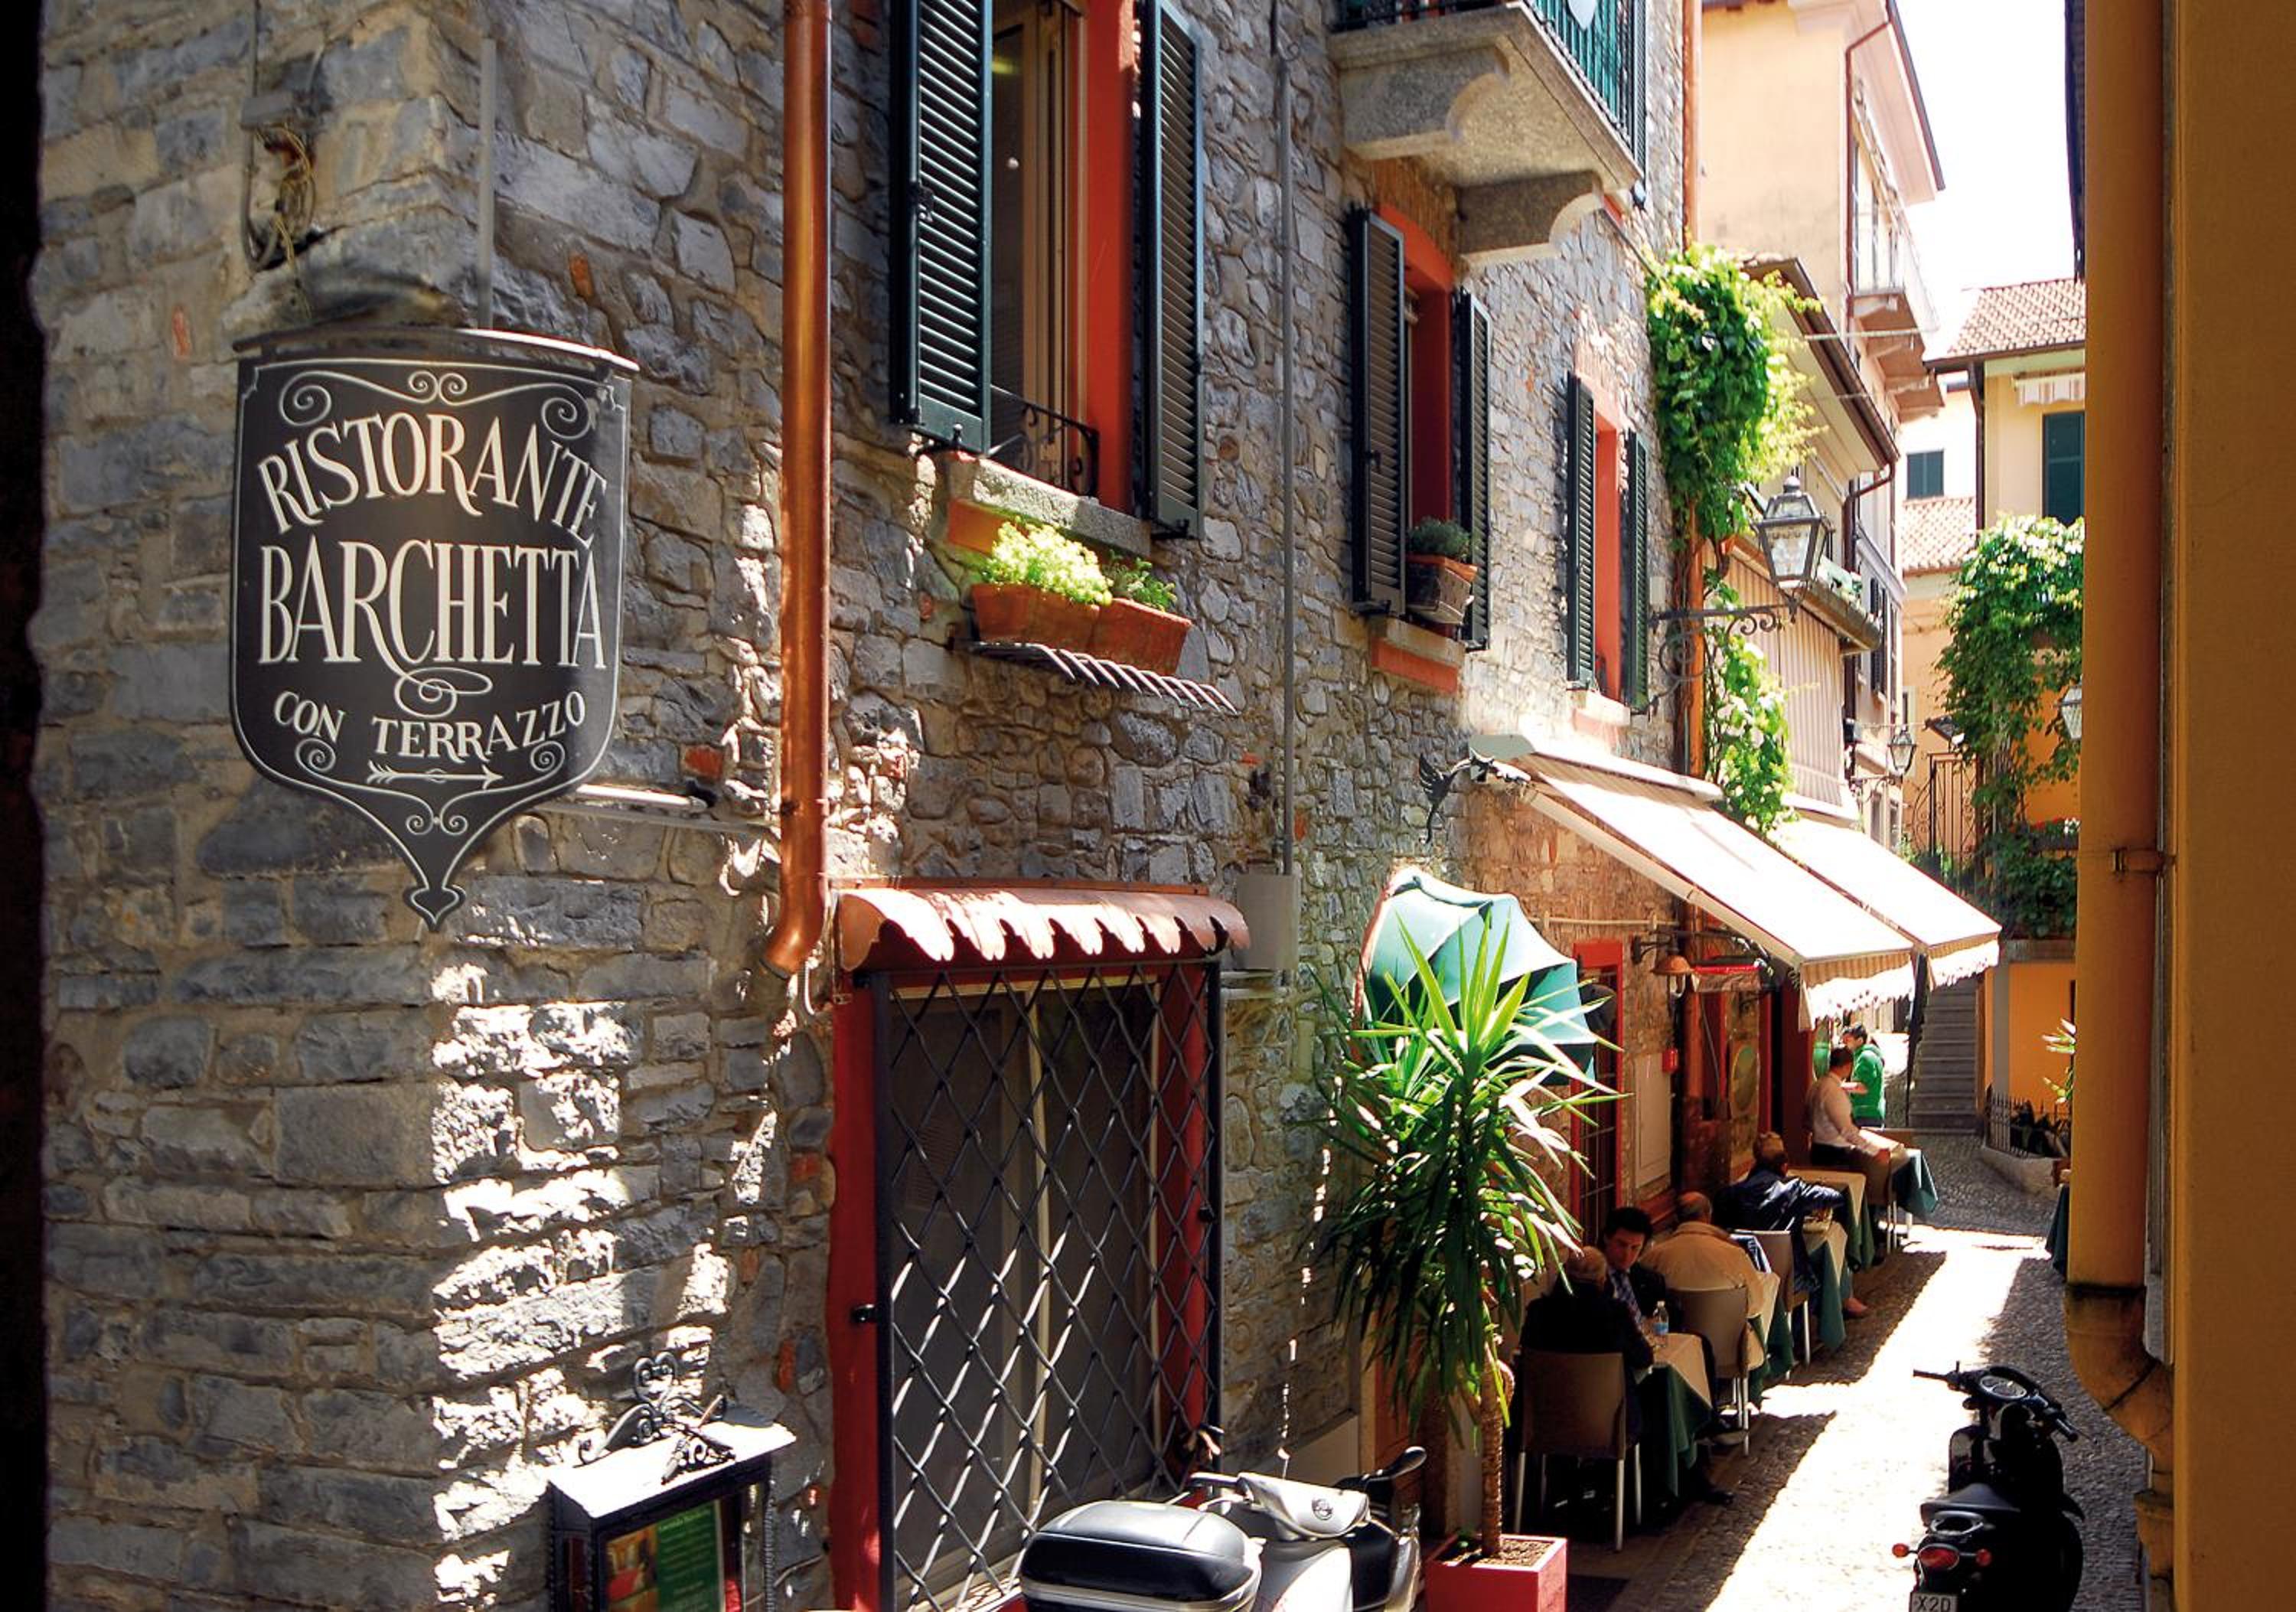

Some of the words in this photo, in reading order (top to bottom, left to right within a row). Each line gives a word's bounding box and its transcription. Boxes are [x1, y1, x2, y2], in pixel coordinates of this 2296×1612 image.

[258, 412, 608, 549] RISTORANTE
[259, 534, 607, 674] BARCHETTA
[274, 691, 347, 742] CON
[372, 690, 586, 764] TERRAZZO
